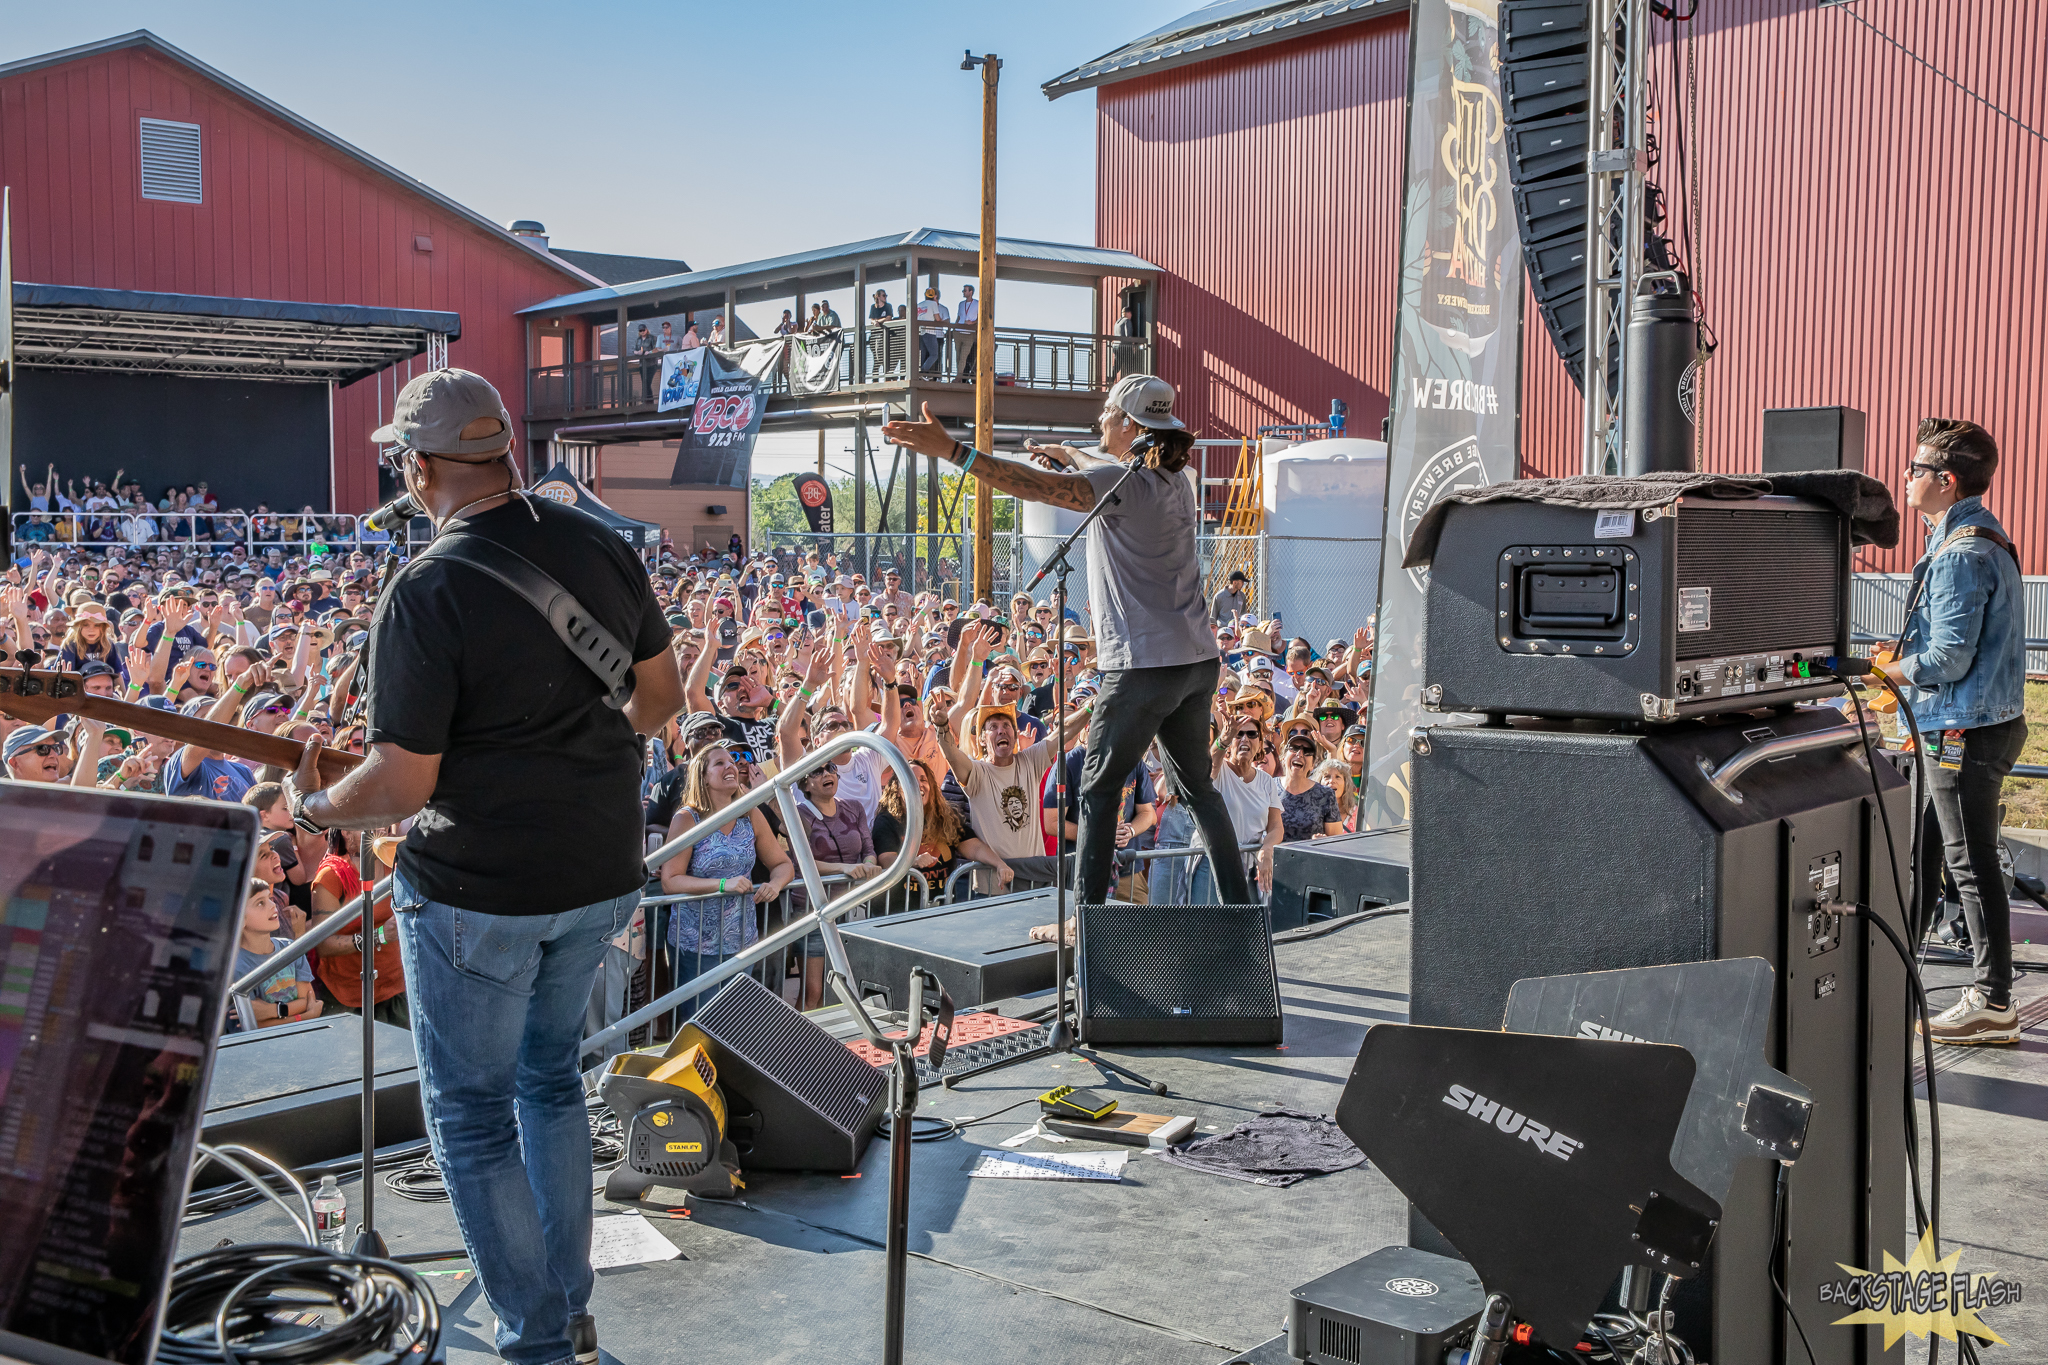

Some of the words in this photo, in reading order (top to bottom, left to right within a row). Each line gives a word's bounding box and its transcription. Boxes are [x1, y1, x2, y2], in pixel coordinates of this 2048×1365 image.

[725, 385, 738, 393] CLASS
[738, 384, 752, 392] ROCK
[1145, 406, 1171, 414] HUMAN
[1152, 400, 1171, 408] STAY
[689, 394, 757, 435] KBCO
[708, 432, 732, 447] 97.3
[733, 432, 746, 442] FM
[746, 734, 769, 750] BE
[752, 748, 777, 763] NIC
[904, 880, 936, 892] GIE
[1442, 1084, 1579, 1161] SHURE
